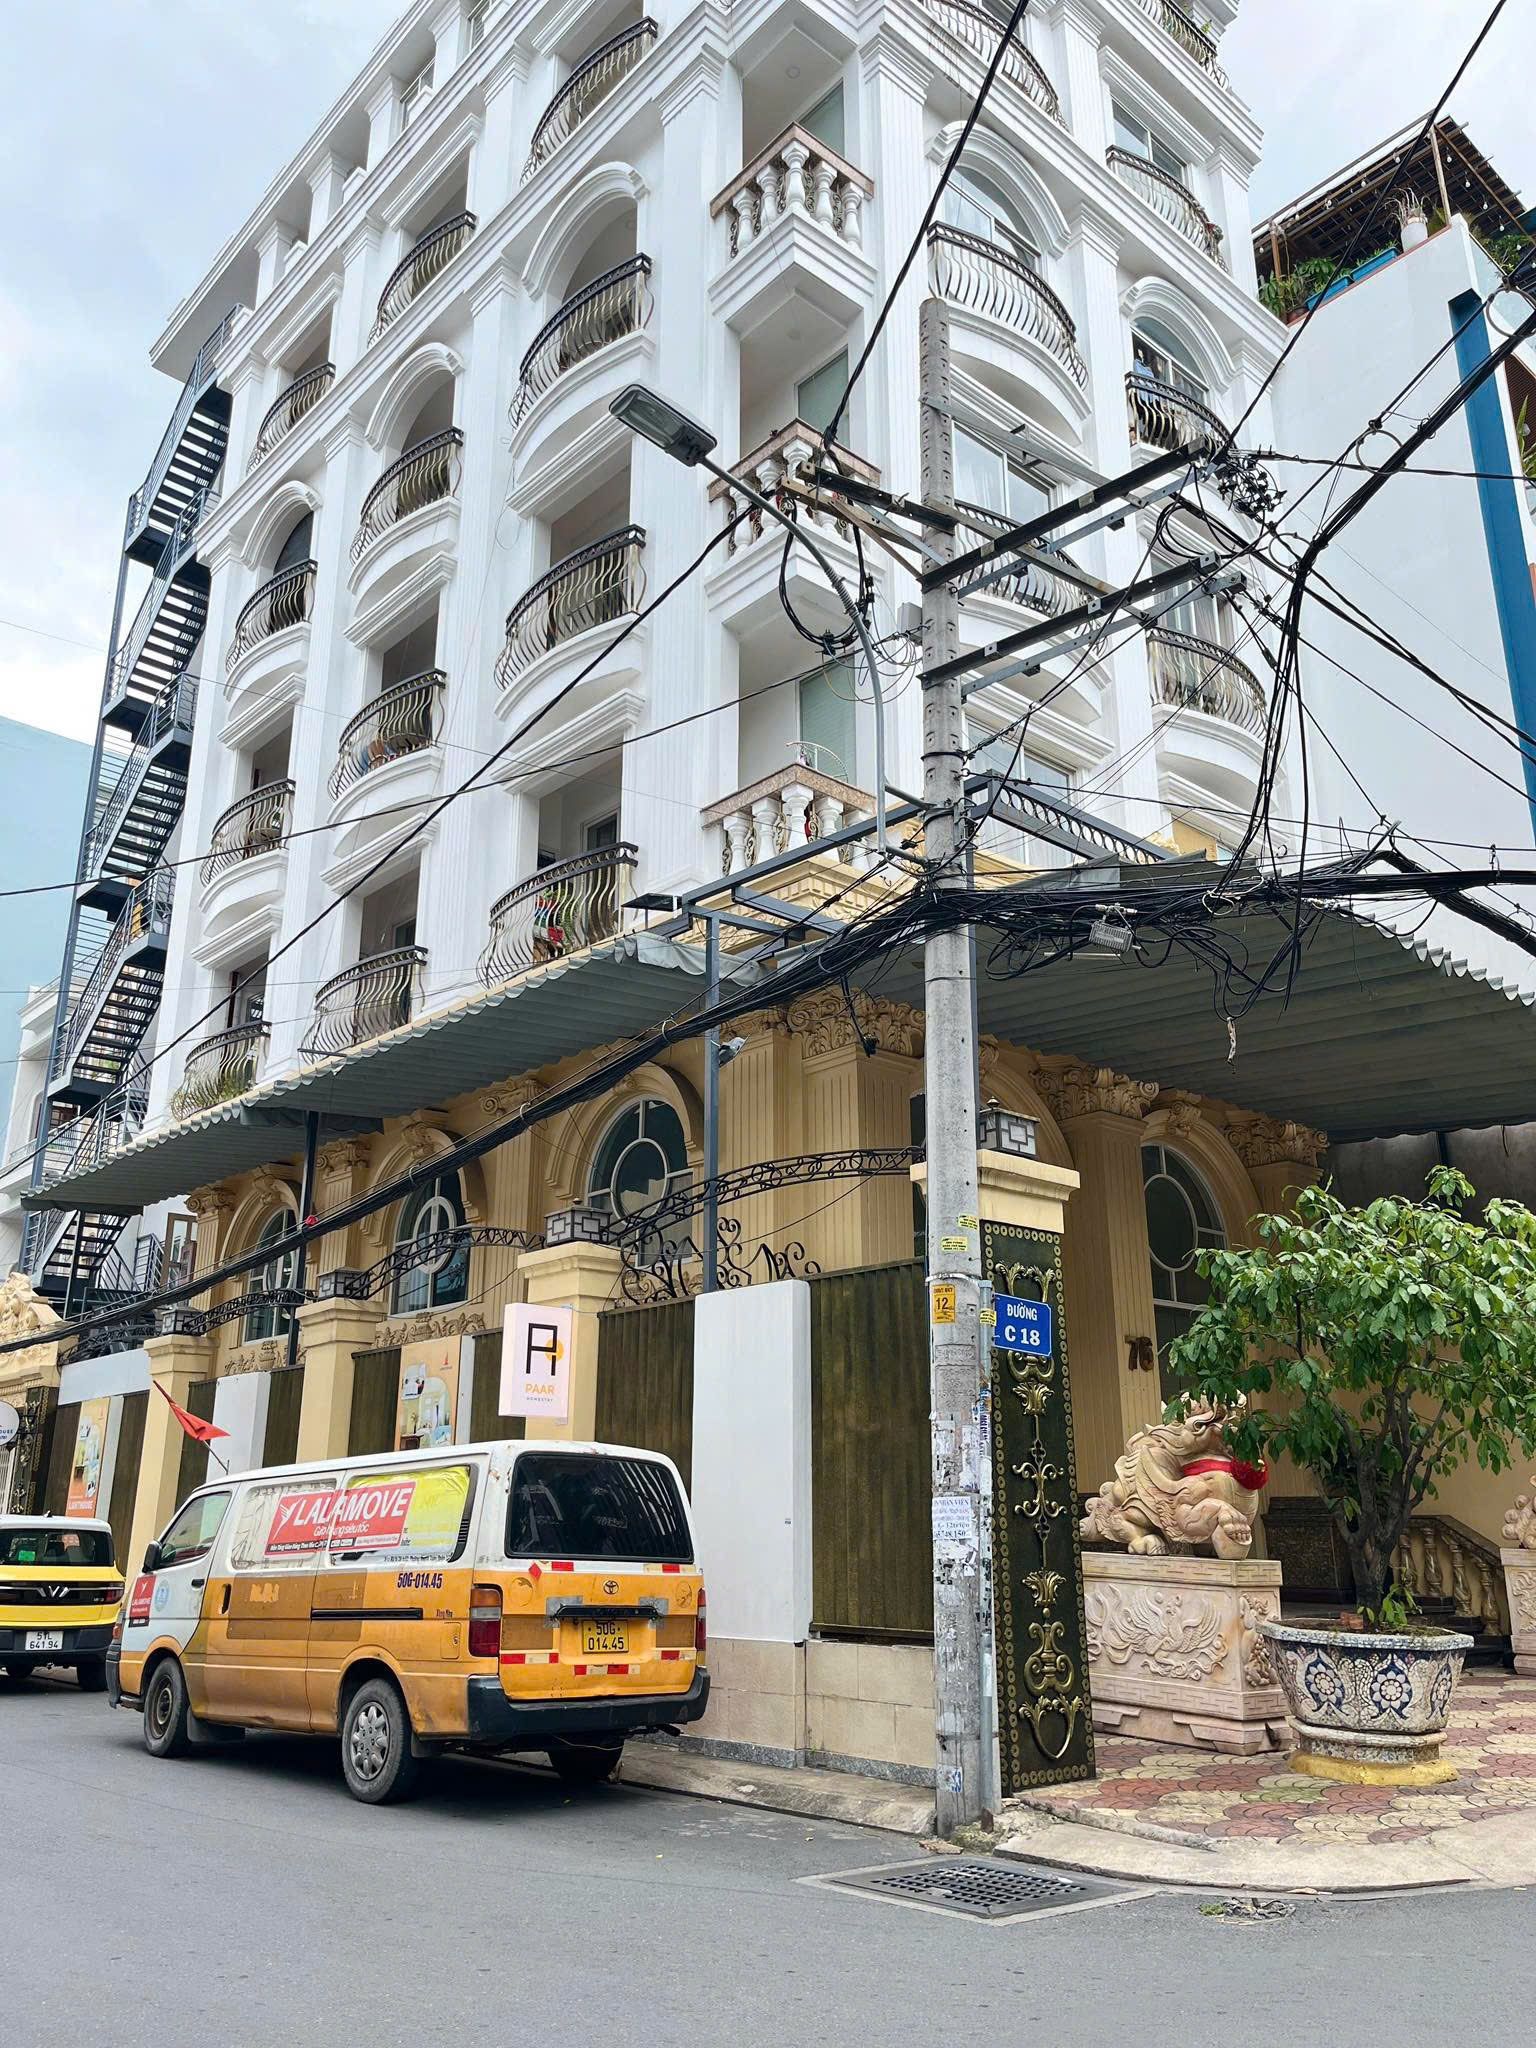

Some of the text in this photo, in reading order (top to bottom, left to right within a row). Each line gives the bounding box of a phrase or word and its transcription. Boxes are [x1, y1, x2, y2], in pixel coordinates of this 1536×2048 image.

[935, 1297, 949, 1310] 12
[1007, 1302, 1038, 1321] ĐƯỜNG
[1004, 1325, 1041, 1346] C 18
[525, 1383, 555, 1395] PAAR
[293, 1487, 413, 1526] LALAMOVE
[397, 1572, 443, 1589] 50G-014.45
[596, 1621, 616, 1636] 50G
[29, 1641, 58, 1649] 641.94
[588, 1637, 624, 1650] 014.45
